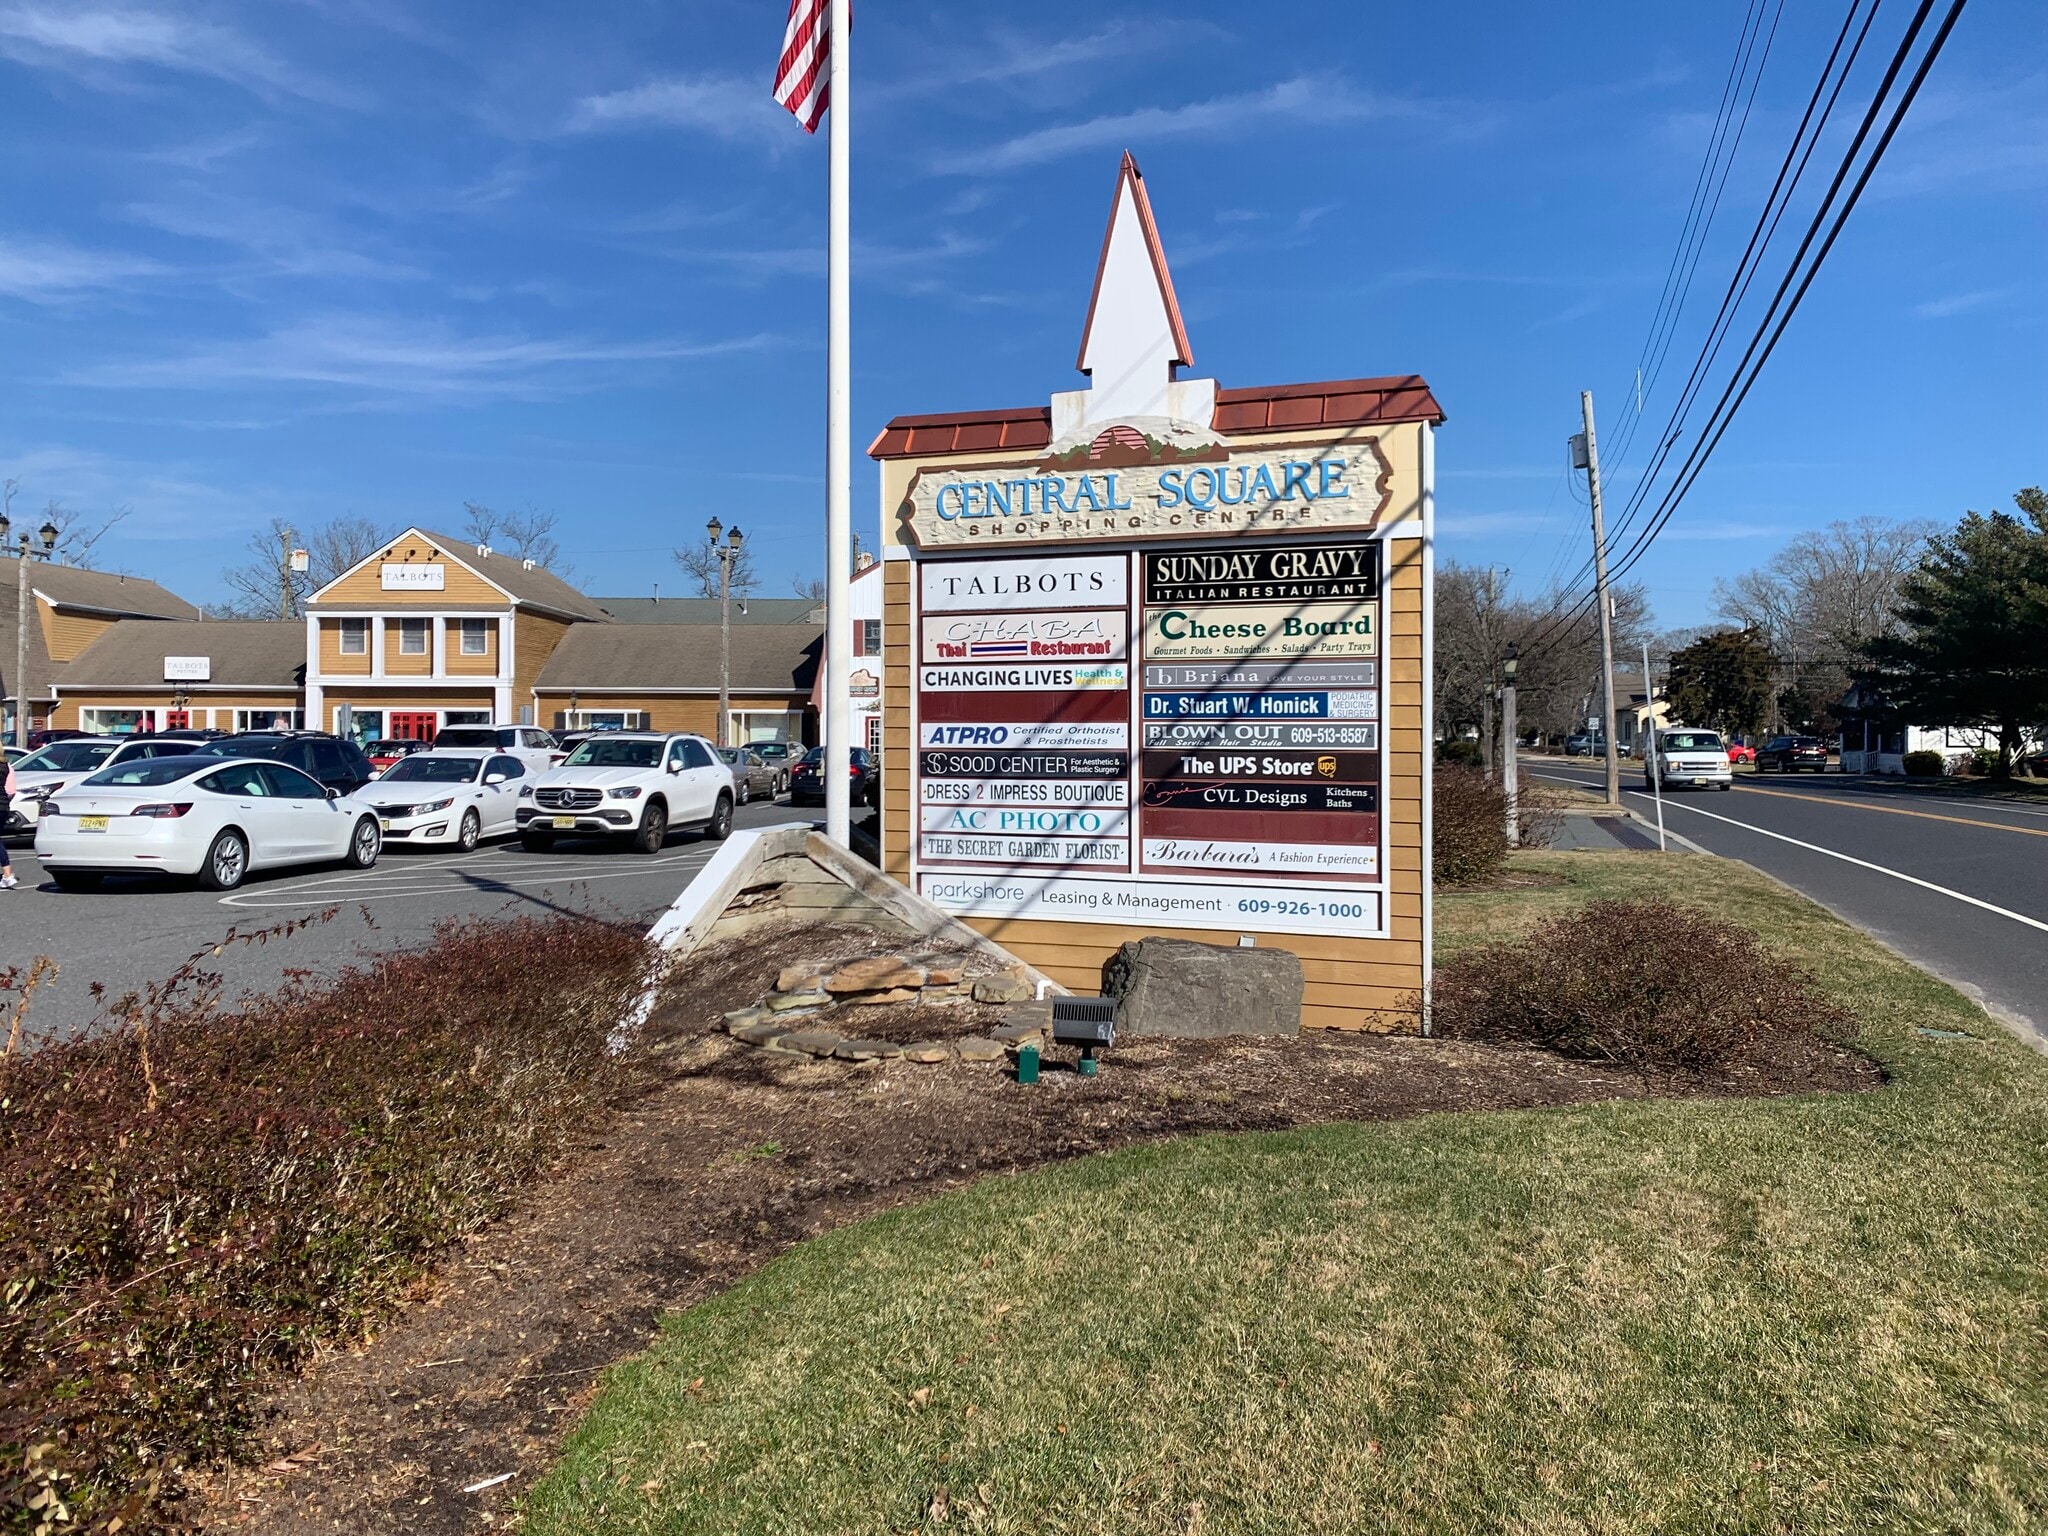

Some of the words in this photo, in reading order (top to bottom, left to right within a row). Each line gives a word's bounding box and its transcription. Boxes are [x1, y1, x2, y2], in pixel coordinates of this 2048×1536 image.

[936, 472, 1132, 521] CENTRAL
[1159, 459, 1350, 512] SQUARE
[969, 516, 1142, 537] SHOPPING
[1169, 507, 1312, 526] CENTRE
[1156, 555, 1261, 583] SUNDAY
[1271, 550, 1366, 579] GRAVY
[384, 573, 442, 581] TALBOTS
[943, 571, 1105, 596] TALBOTS
[1156, 588, 1231, 600] ITALIAN
[1239, 584, 1367, 598] RESTAURANT
[944, 618, 1104, 641] CHABA
[1160, 611, 1267, 640] Cheese
[1283, 616, 1372, 636] Board
[937, 642, 967, 658] Thai
[1031, 640, 1111, 655] Restaurant
[1154, 647, 1187, 655] Gourmet
[1190, 646, 1213, 654] Foods
[1223, 645, 1270, 654] Sandwiches
[1282, 644, 1309, 653] Salads
[1321, 642, 1344, 653] Party
[1349, 642, 1371, 651] Trays
[926, 671, 1019, 686] CHANGING
[1025, 670, 1072, 685] LIVES
[1075, 670, 1111, 678] Health
[1114, 669, 1123, 677] &
[1075, 677, 1124, 686] Wellness
[1184, 670, 1259, 682] Briana
[1330, 693, 1373, 701] PODIATRIC
[1332, 700, 1371, 709] MEDICINE
[1151, 699, 1173, 714] Dr.
[1179, 699, 1228, 714] Stuart
[1234, 698, 1254, 714] W.
[1261, 697, 1319, 714] Honick
[1338, 709, 1375, 717] SURGERY
[929, 726, 1008, 744] ATPRO
[1013, 727, 1062, 735] Certified
[1068, 726, 1120, 735] Orthotist
[1149, 726, 1226, 739] BLOWN
[1235, 725, 1283, 739] OUT
[1291, 728, 1368, 743] 609-513-8587
[1038, 737, 1108, 745] Prosthetists
[950, 757, 995, 772] SOOD
[1000, 757, 1067, 773] CENTER
[1181, 757, 1214, 773] The
[1219, 757, 1257, 774] UPS
[1262, 758, 1313, 775] Store
[1319, 761, 1335, 775] ups
[927, 784, 969, 799] DRESS
[977, 784, 984, 800] 2
[991, 785, 1047, 800] IMPRESS
[1055, 785, 1123, 801] BOUTIQUE
[1204, 789, 1240, 802] CVL
[1245, 790, 1307, 806] Designs
[1326, 788, 1368, 796] Kitchens
[1326, 799, 1352, 807] Baths
[950, 810, 987, 829] AC
[1000, 812, 1101, 832] PHOTO
[929, 839, 952, 854] THE
[958, 840, 1003, 856] SECRET
[1009, 842, 1059, 858] GARDEN
[1066, 843, 1120, 860] FLORIST
[1152, 841, 1260, 864] Barbara's
[1269, 852, 1276, 861] A
[1280, 852, 1313, 863] Fashion
[1317, 853, 1368, 866] Experience
[933, 881, 1024, 901] parkshore
[1041, 890, 1097, 908] Leasing
[1102, 893, 1112, 906] &
[1117, 894, 1222, 912] Management
[1238, 899, 1362, 917] 609-926-1000
